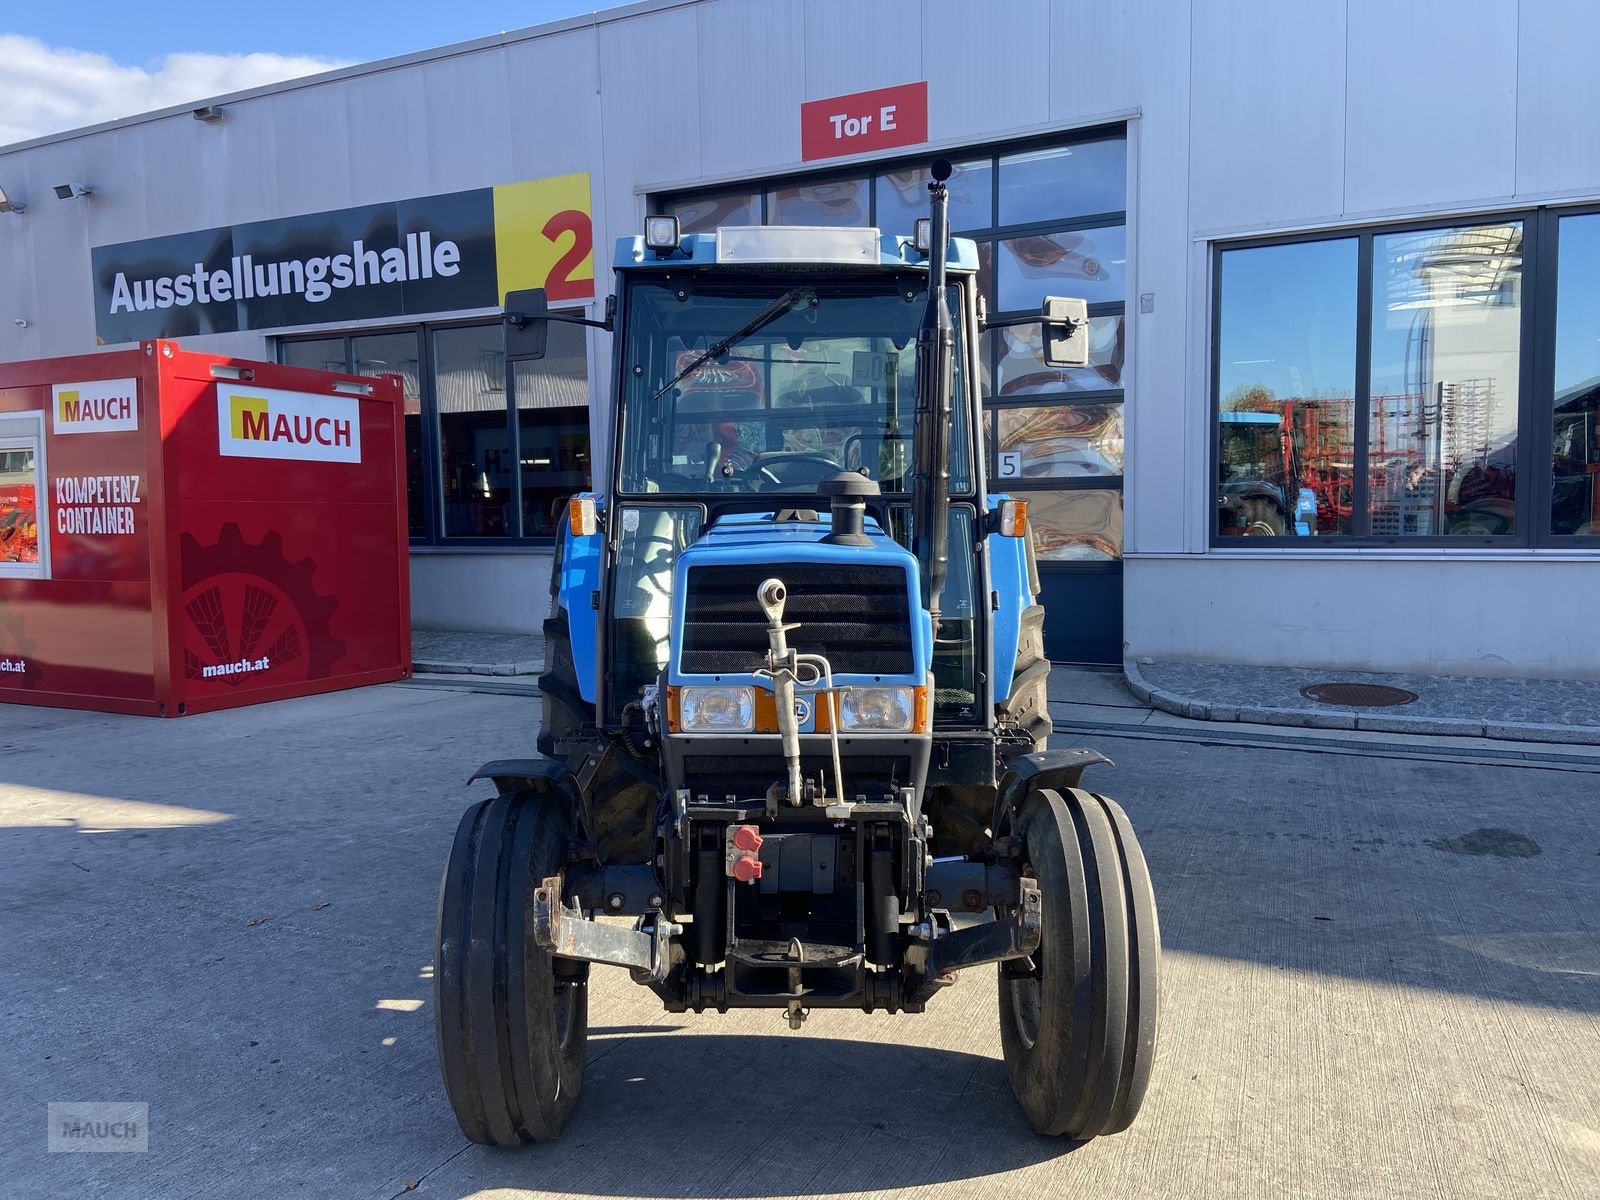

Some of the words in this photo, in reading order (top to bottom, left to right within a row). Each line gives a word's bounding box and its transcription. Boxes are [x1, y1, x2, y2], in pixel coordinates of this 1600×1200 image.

[829, 113, 872, 139] Tor
[880, 105, 897, 131] E
[109, 231, 461, 314] Ausstellungshalle
[541, 209, 595, 302] 2
[64, 397, 131, 422] MAUCH
[242, 410, 351, 447] MAUCH
[1003, 456, 1015, 475] 5
[56, 475, 140, 504] KOMPETENZ
[57, 506, 135, 534] CONTAINER
[0, 659, 26, 673] ch.at
[203, 656, 269, 677] mauch.at
